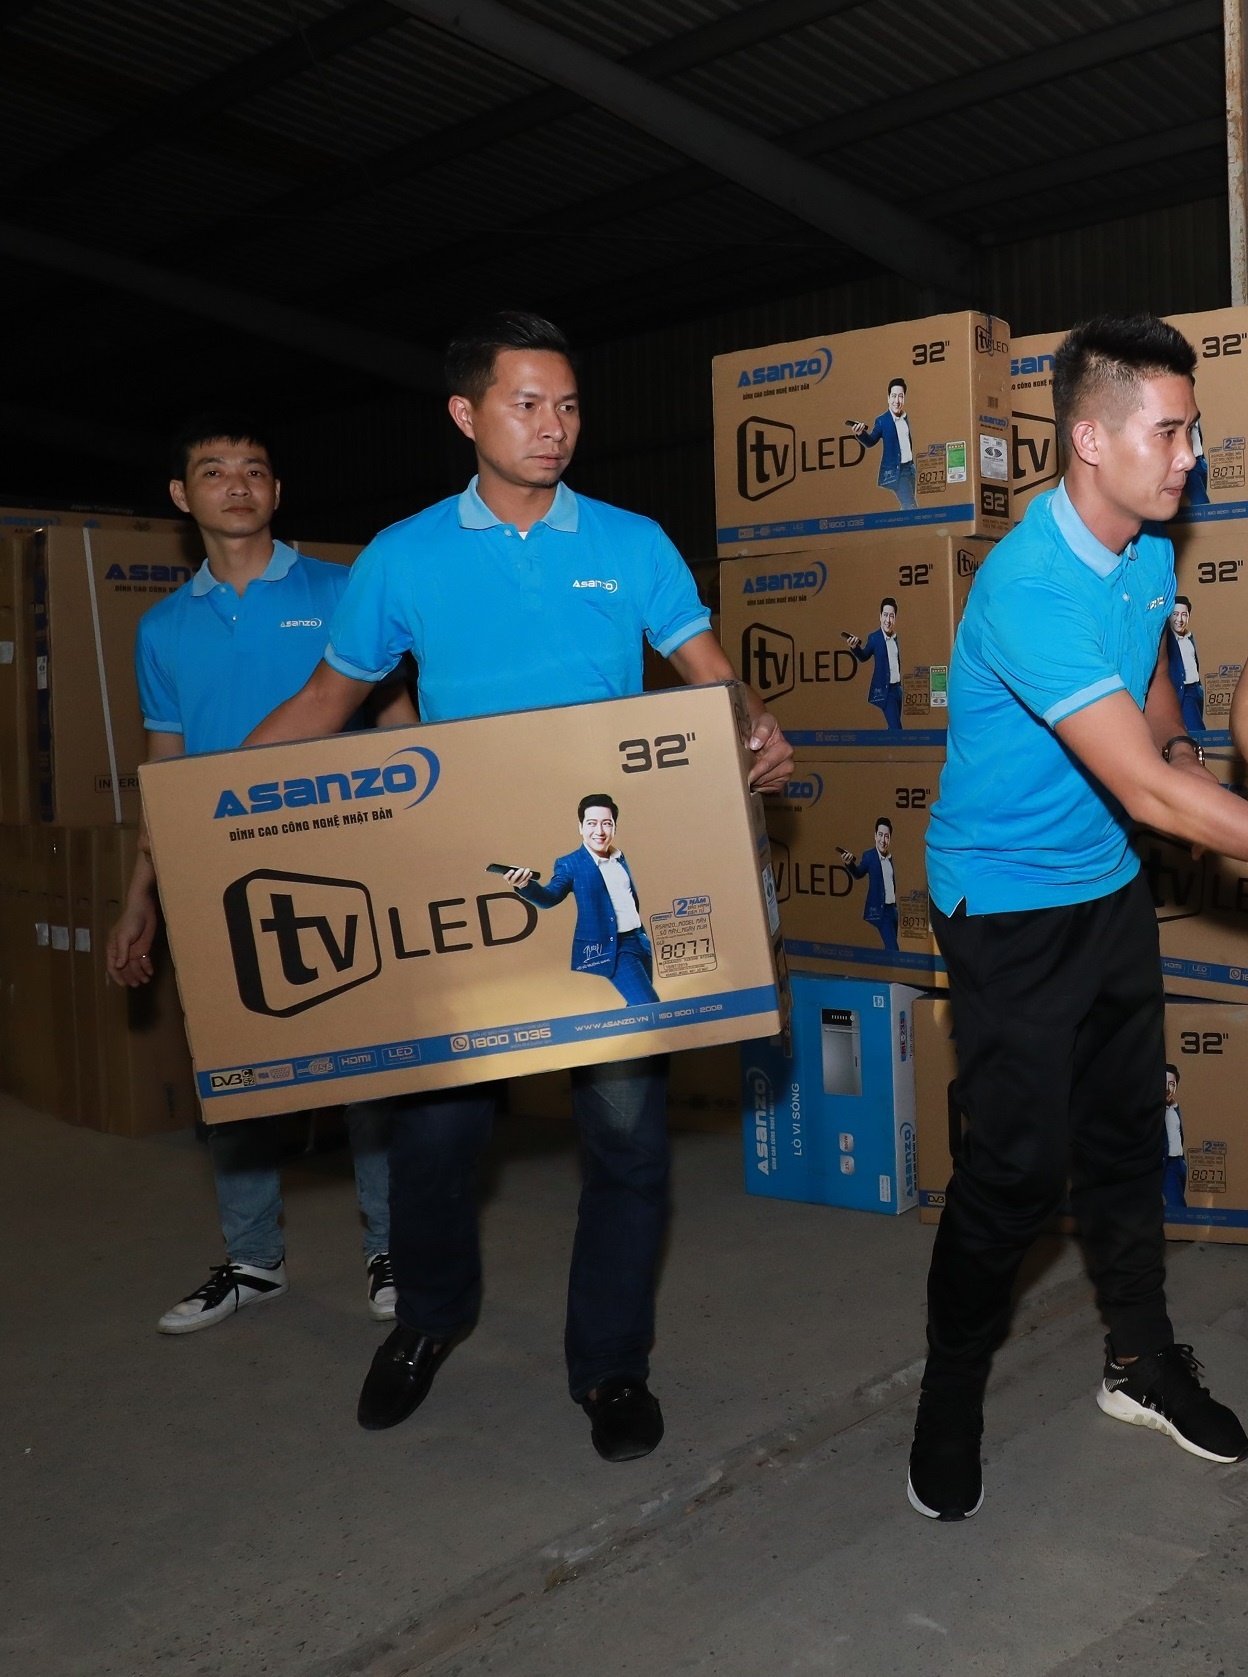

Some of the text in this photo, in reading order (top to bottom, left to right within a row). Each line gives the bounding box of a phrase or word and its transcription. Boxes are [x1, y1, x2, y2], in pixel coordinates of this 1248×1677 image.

[801, 434, 866, 472] LED
[919, 471, 943, 482] 8077
[1213, 465, 1242, 478] 8077
[799, 650, 858, 683] LED
[905, 693, 929, 704] 8077
[1209, 693, 1234, 703] 807
[229, 808, 393, 842] ĐỈNH CAO CÔNG NGHỆ NHẬT BẢN
[795, 864, 853, 897] LED
[676, 899, 688, 915] 2
[259, 891, 538, 985] tv LED
[661, 938, 709, 960] 8077
[658, 1012, 673, 1020] ISO
[471, 1035, 509, 1049] 1800
[514, 1027, 551, 1043] 1035
[388, 1047, 413, 1058] LED
[789, 1083, 802, 1156] LÒ VI SÓNG
[1192, 1170, 1223, 1180] 8077
